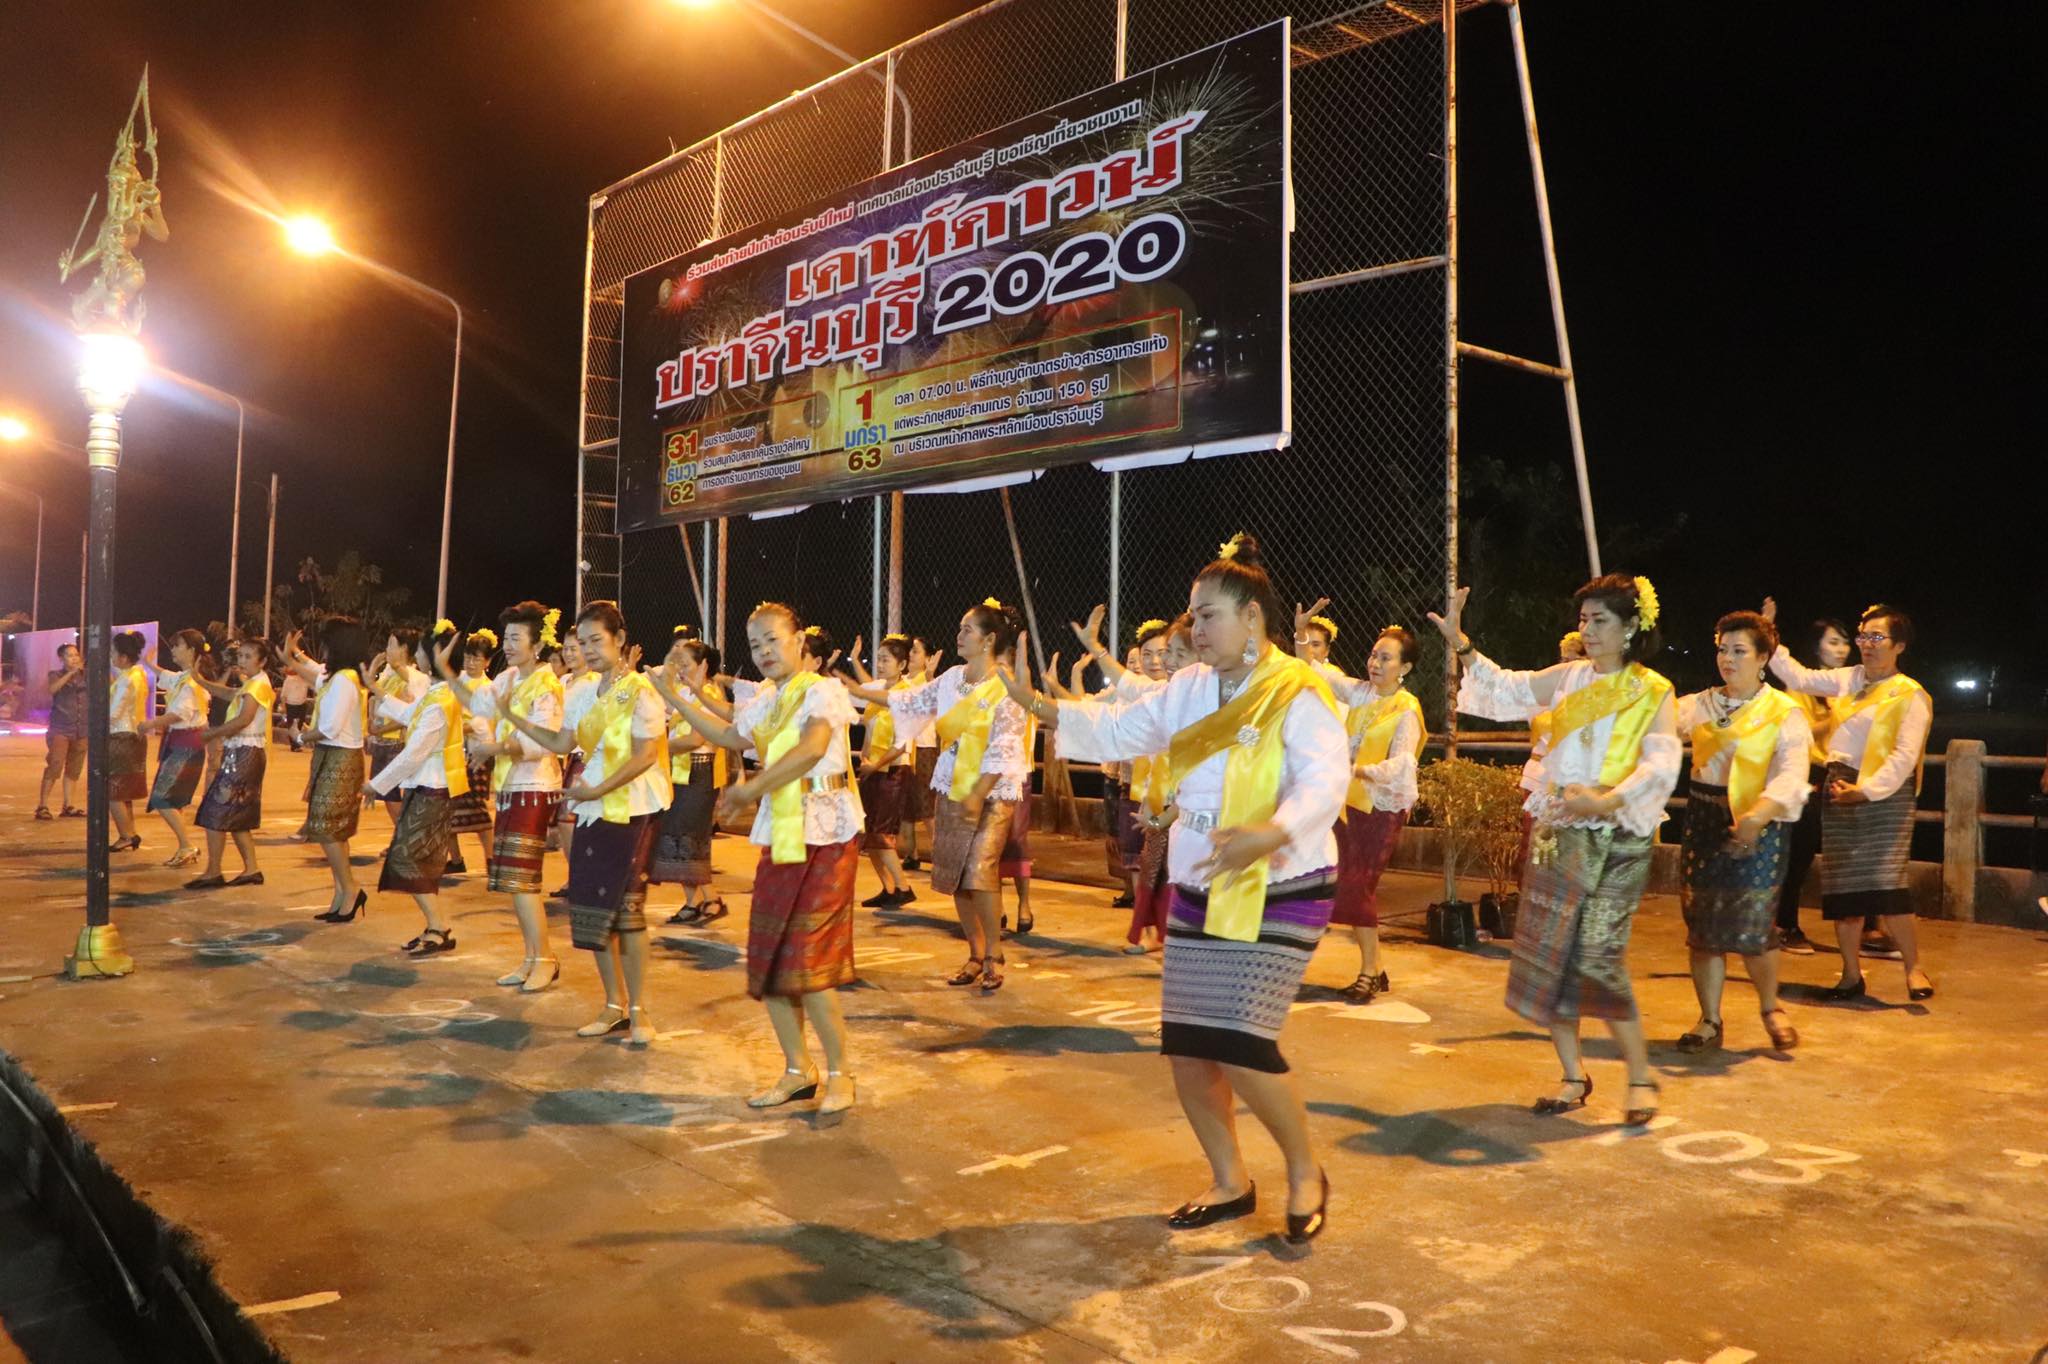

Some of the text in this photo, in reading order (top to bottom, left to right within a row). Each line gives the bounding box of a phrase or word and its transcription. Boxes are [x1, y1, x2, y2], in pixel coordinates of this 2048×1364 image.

[687, 99, 1141, 280] ร่วมส่งท้ายปีเก่าต้อนรับปีใหม่ เทศบาลเมืองปราจีนบุรี ขอเชิญเที่ยวชมงาน
[656, 213, 1185, 409] ปราจีนบุรี 2020
[894, 334, 1168, 406] เวลา 07.00 น. พิธีทำบุญตักบาตรข้าวสารอาหารแห้ง
[856, 389, 873, 421] 1
[1017, 388, 1054, 408] จำนวน
[1059, 381, 1086, 399] 150
[1091, 375, 1109, 396] รูป
[667, 430, 698, 460] 31
[845, 424, 886, 449] มกรา
[893, 442, 905, 456] ณ
[666, 460, 698, 485] ธันวา
[848, 447, 882, 472] 63
[669, 482, 695, 504] 62
[1140, 1255, 1408, 1359] 102
